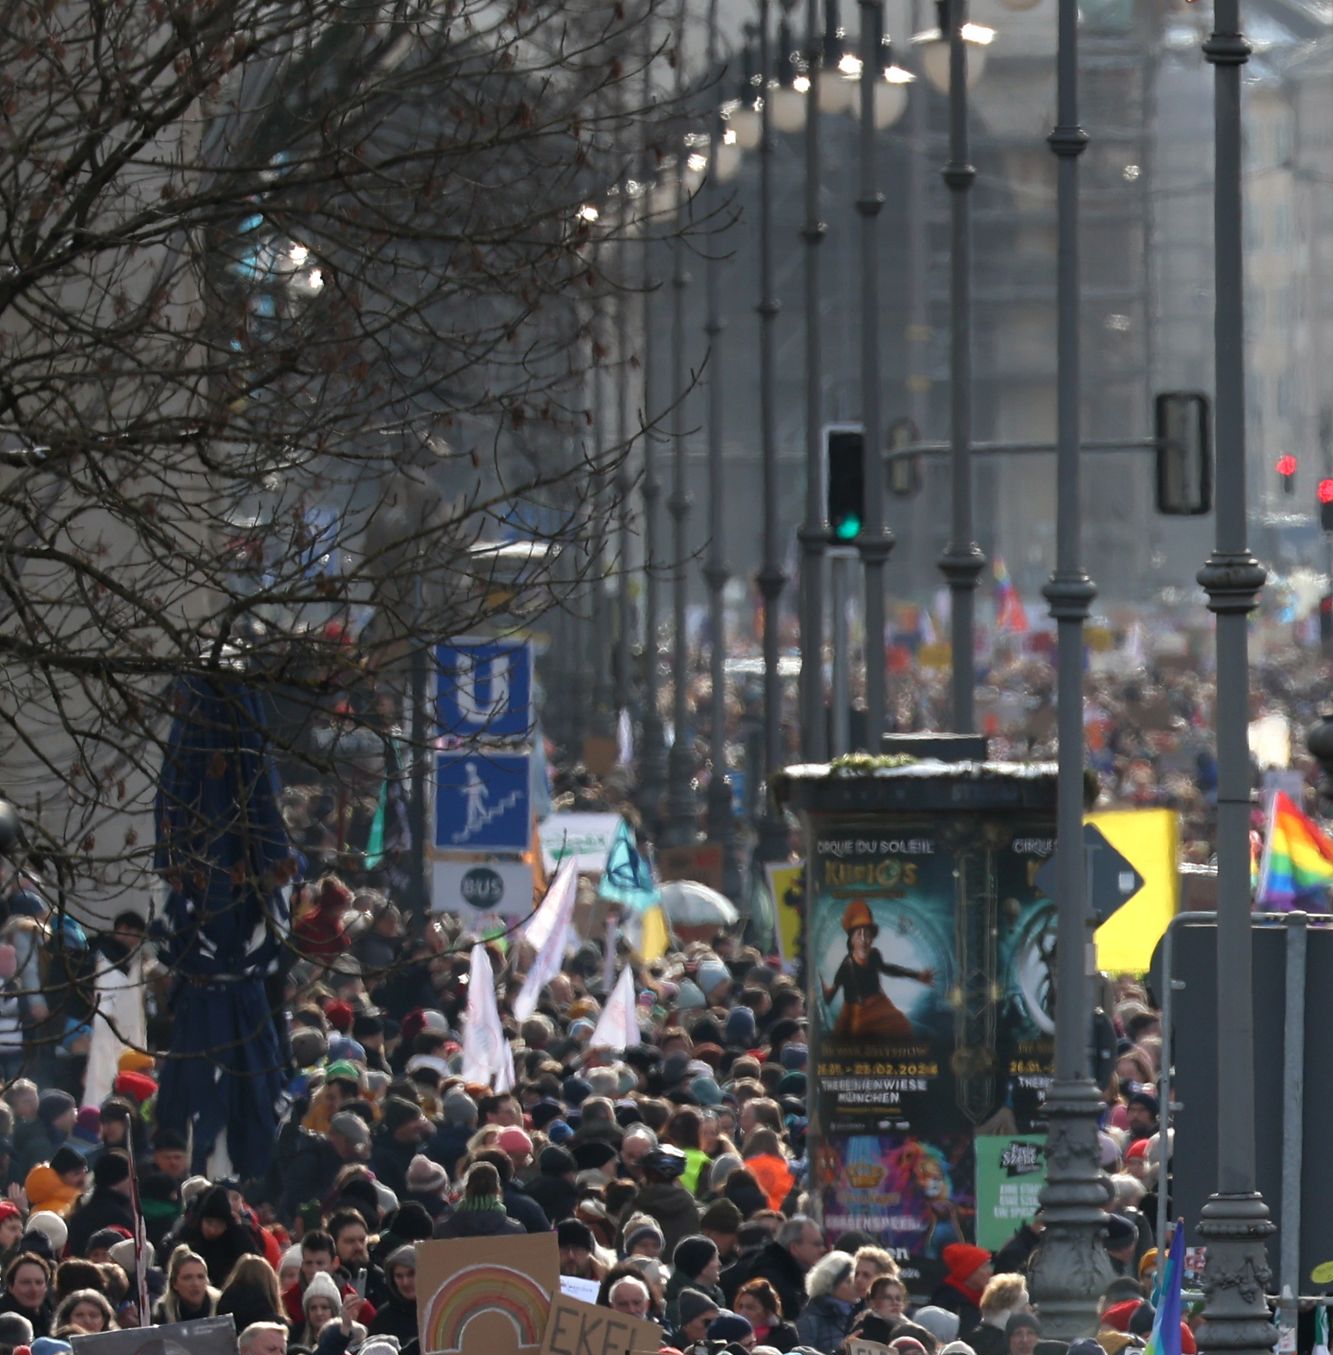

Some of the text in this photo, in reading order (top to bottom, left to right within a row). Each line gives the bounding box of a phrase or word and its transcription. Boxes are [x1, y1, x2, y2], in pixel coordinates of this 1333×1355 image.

[455, 651, 510, 725] U
[880, 840, 934, 853] SOLEIL
[464, 876, 501, 895] BUS
